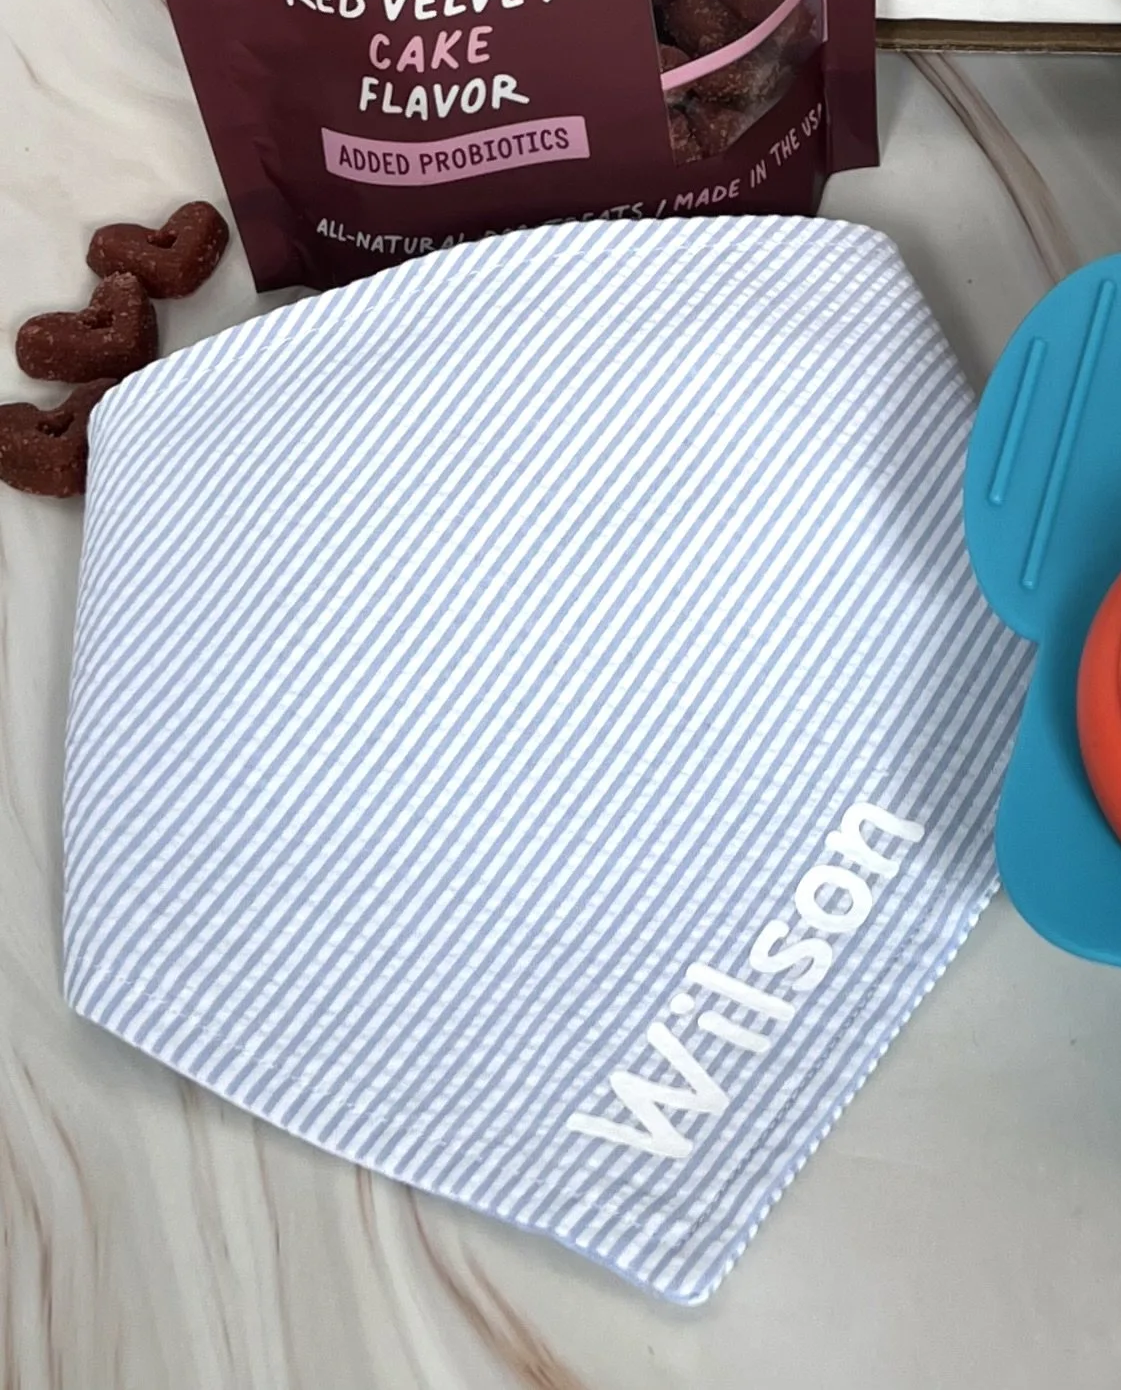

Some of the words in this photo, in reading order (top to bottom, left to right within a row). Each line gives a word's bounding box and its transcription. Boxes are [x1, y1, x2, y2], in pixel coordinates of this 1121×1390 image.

[369, 25, 493, 73] CAKE
[359, 73, 530, 121] FLAVOR
[338, 144, 410, 176] ADDED
[419, 127, 570, 175] PROBIOTICS
[673, 178, 741, 211] MADE
[750, 159, 767, 188] IN
[769, 128, 801, 166] THE
[565, 800, 926, 1160] Wilson
